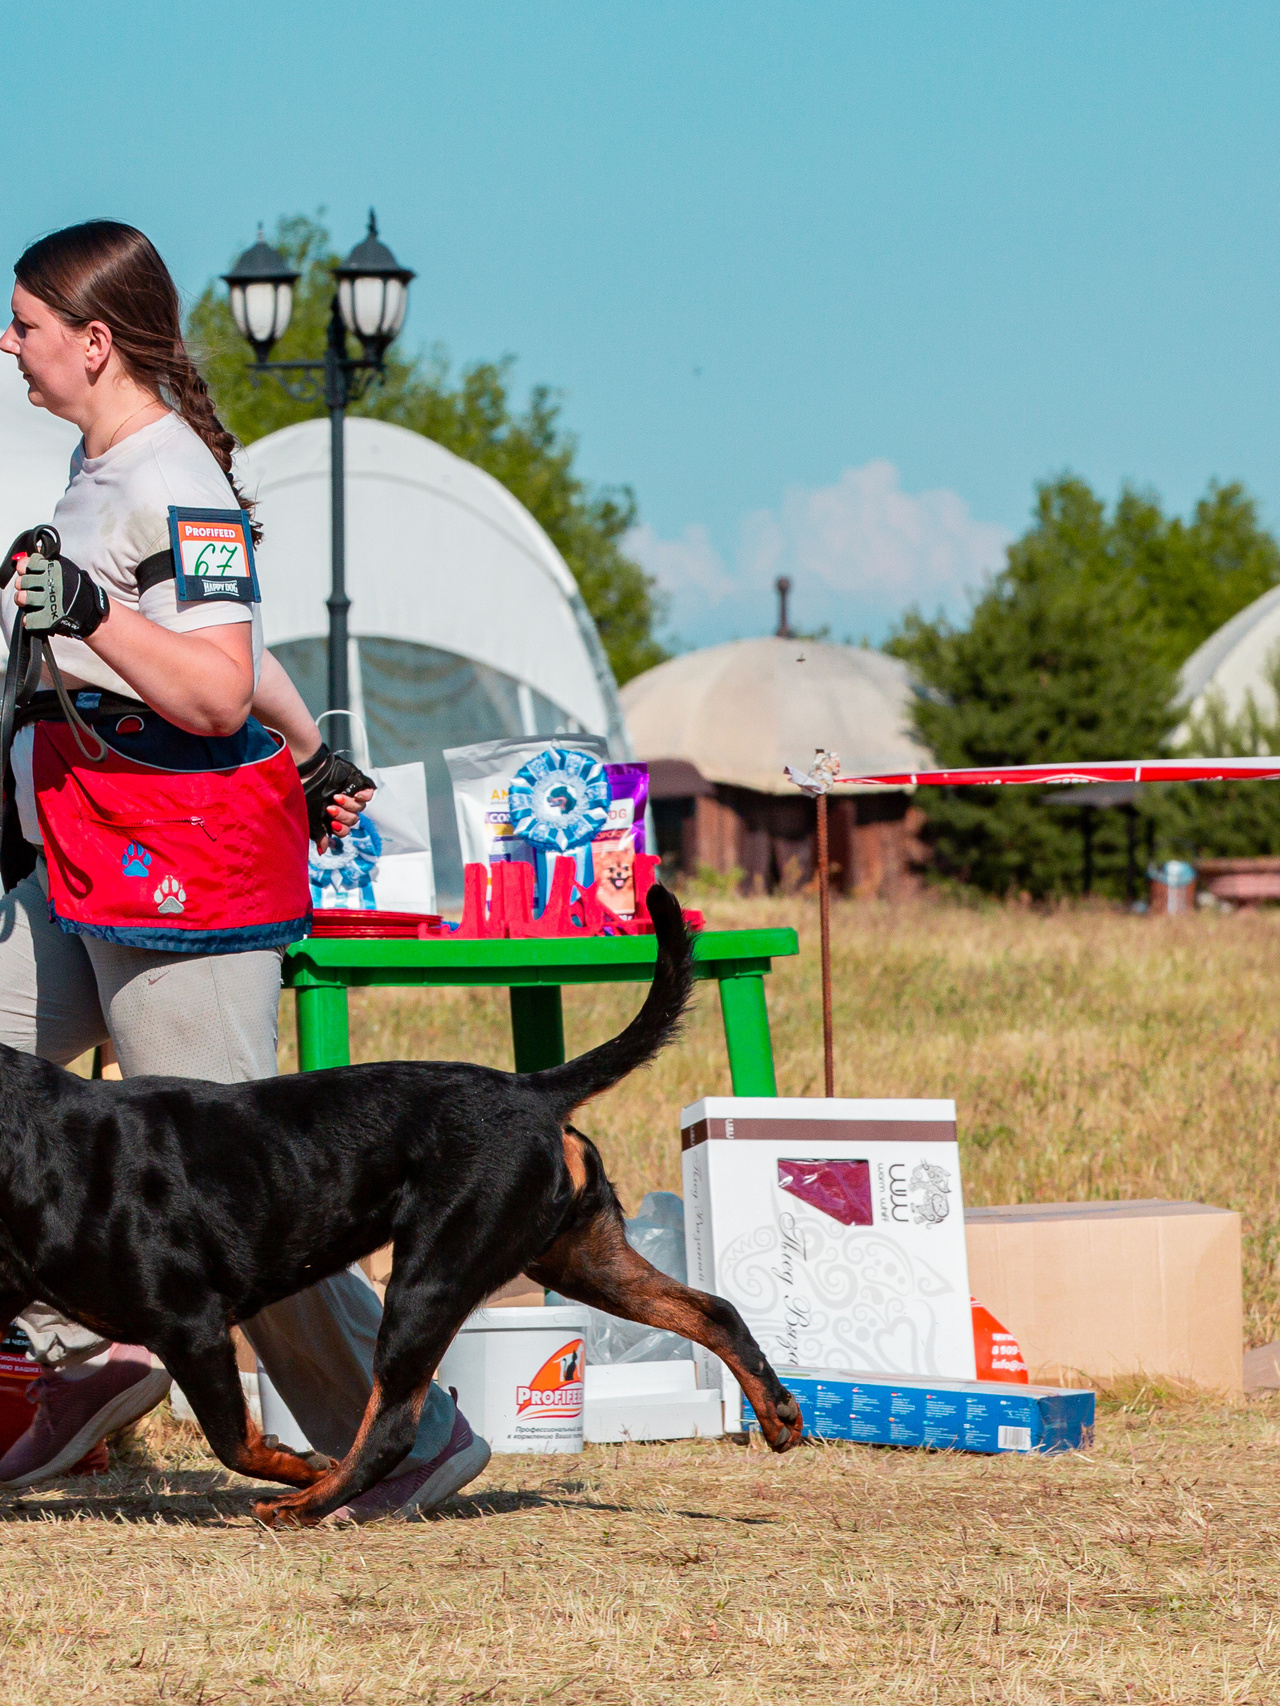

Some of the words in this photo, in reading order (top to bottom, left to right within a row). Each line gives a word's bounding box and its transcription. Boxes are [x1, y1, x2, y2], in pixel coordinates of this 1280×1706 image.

[185, 525, 236, 538] PROFIFEED
[194, 543, 238, 576] 67
[203, 581, 225, 593] HAPPY
[225, 581, 239, 593] DOG
[878, 1163, 886, 1193] warm
[776, 1295, 811, 1366] Вяза
